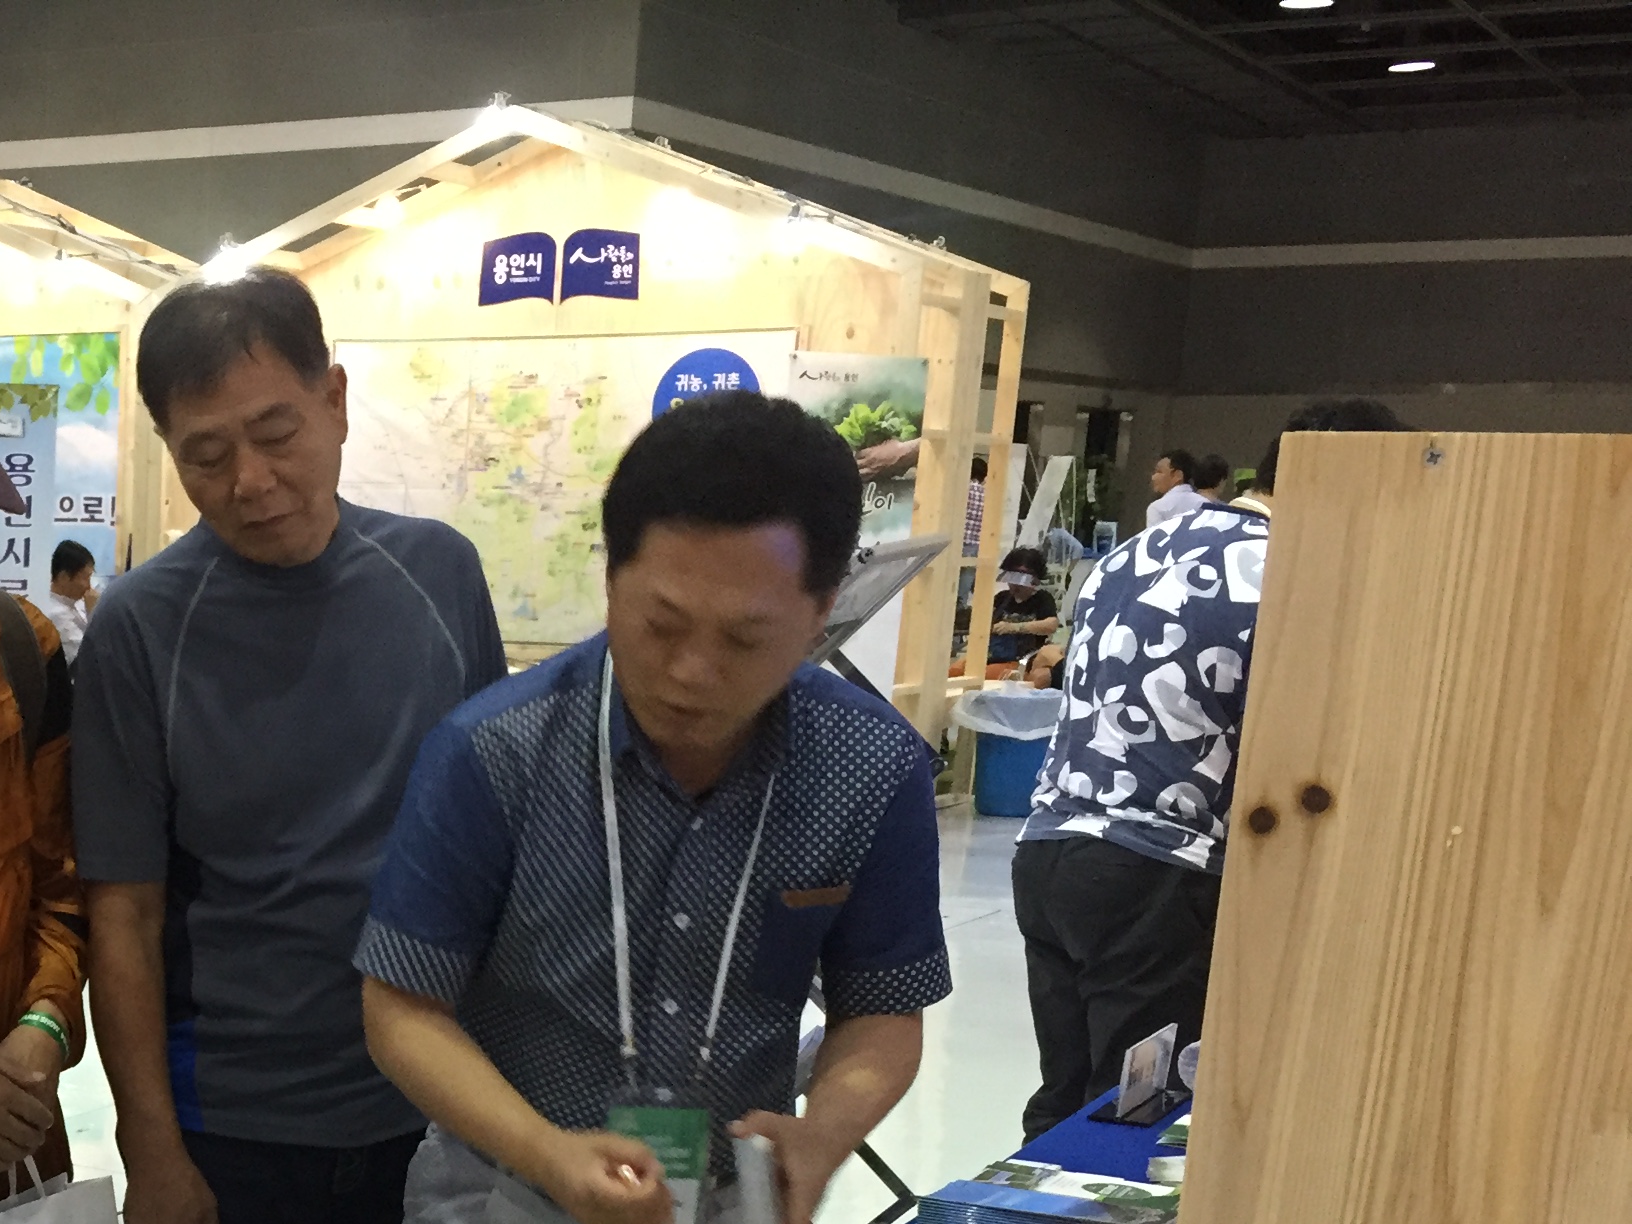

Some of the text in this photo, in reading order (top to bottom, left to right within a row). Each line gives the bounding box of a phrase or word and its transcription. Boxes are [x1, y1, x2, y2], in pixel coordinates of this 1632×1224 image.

[492, 252, 543, 285] 용인시
[611, 263, 633, 279] 용인
[712, 371, 741, 391] 귀촌
[53, 495, 116, 527] 으로!
